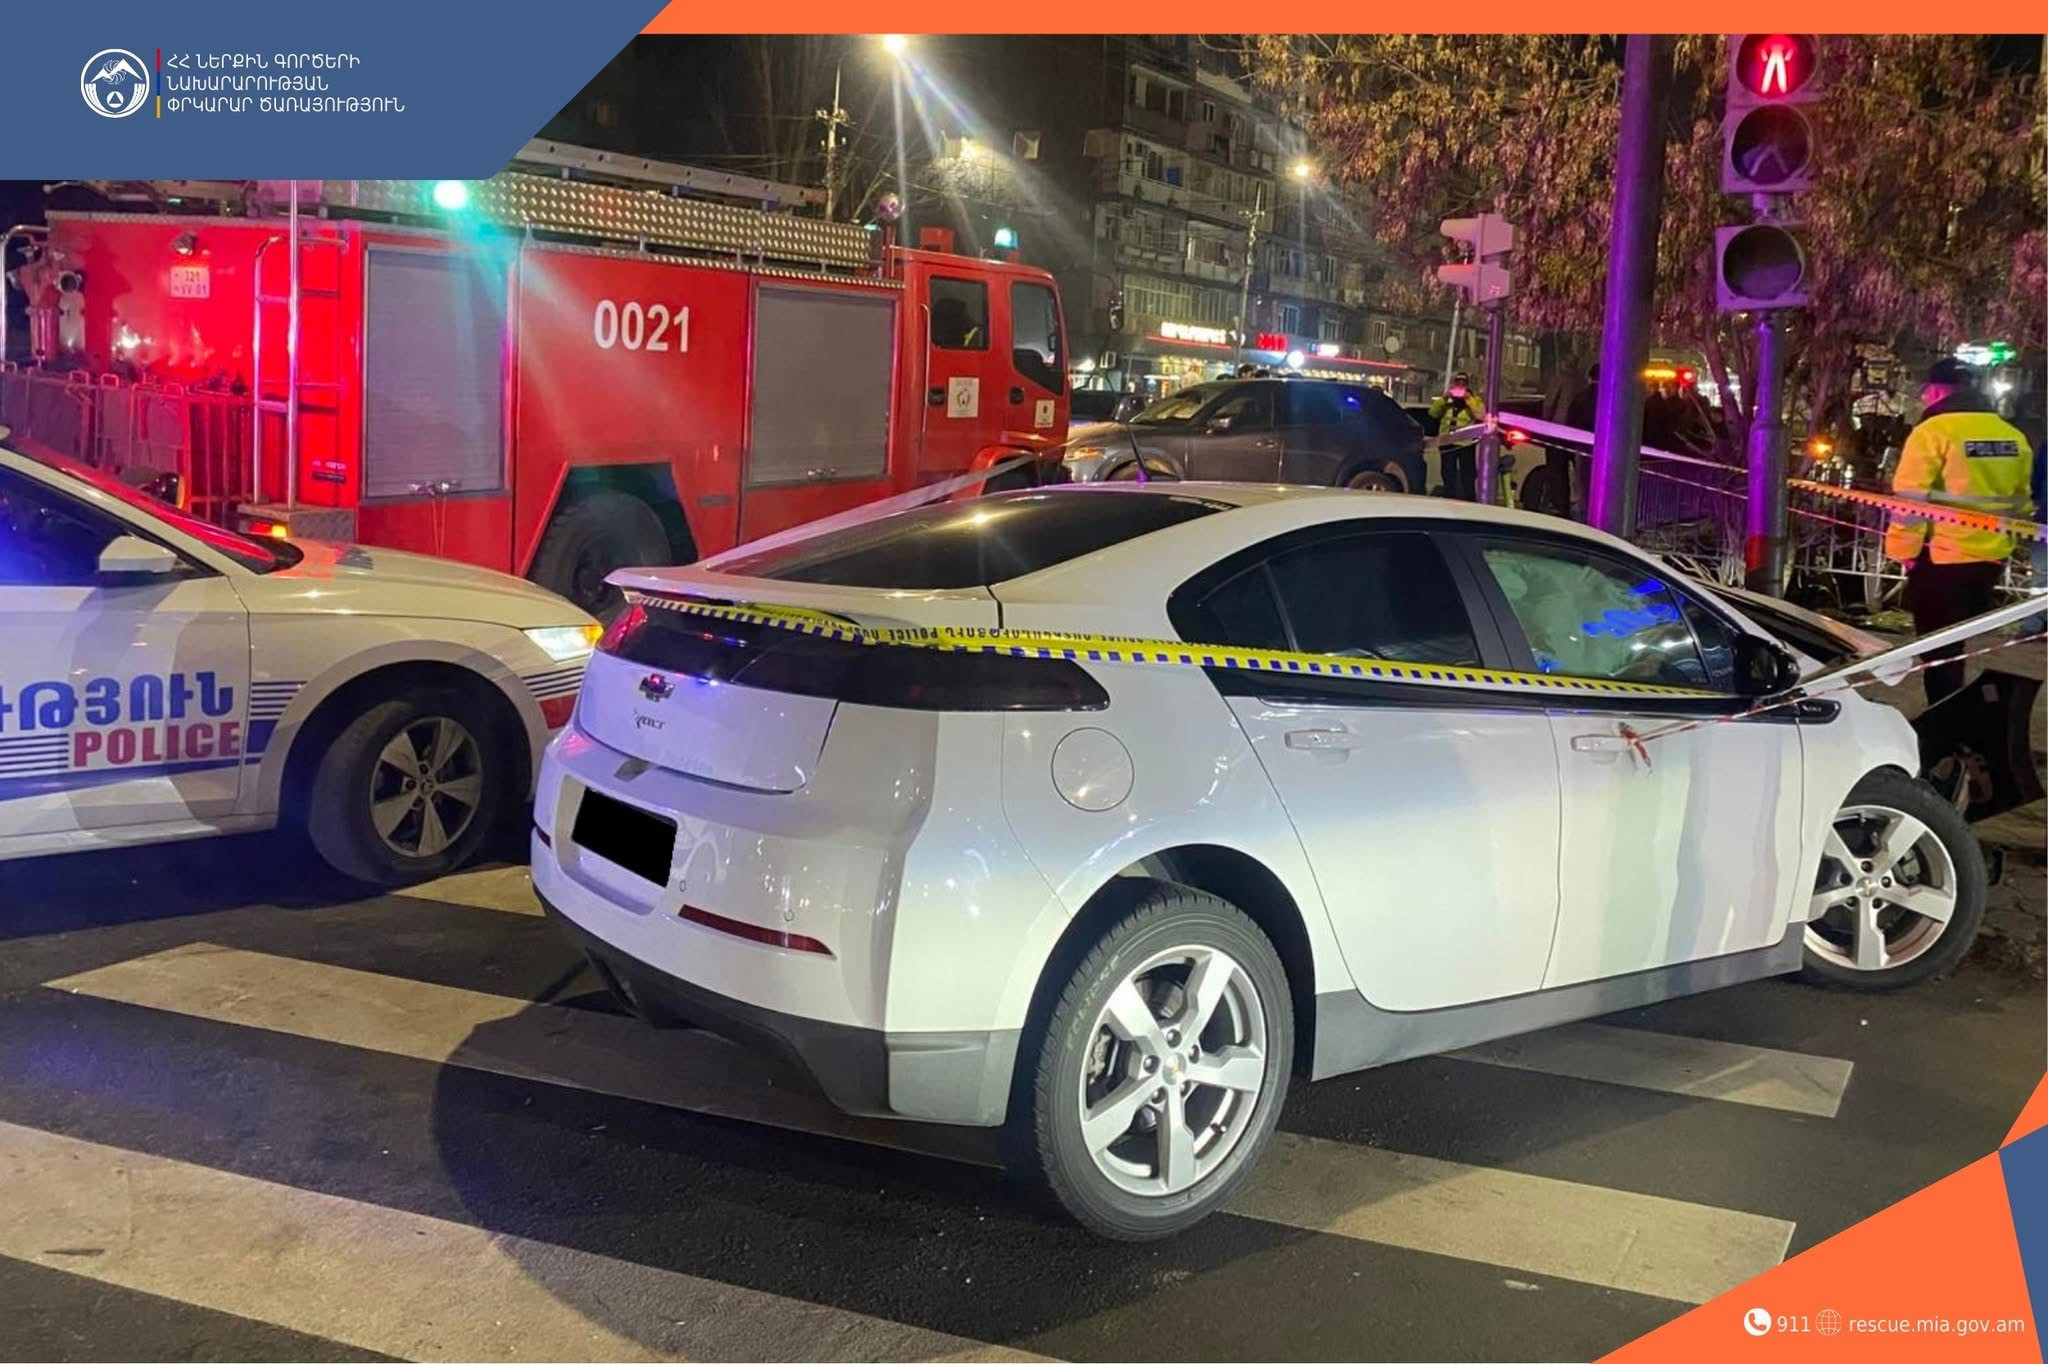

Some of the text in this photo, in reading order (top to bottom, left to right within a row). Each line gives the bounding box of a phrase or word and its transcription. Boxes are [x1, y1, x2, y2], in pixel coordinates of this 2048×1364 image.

[594, 299, 690, 353] 0021
[888, 626, 938, 641] POLICE
[74, 722, 240, 767] POLICE
